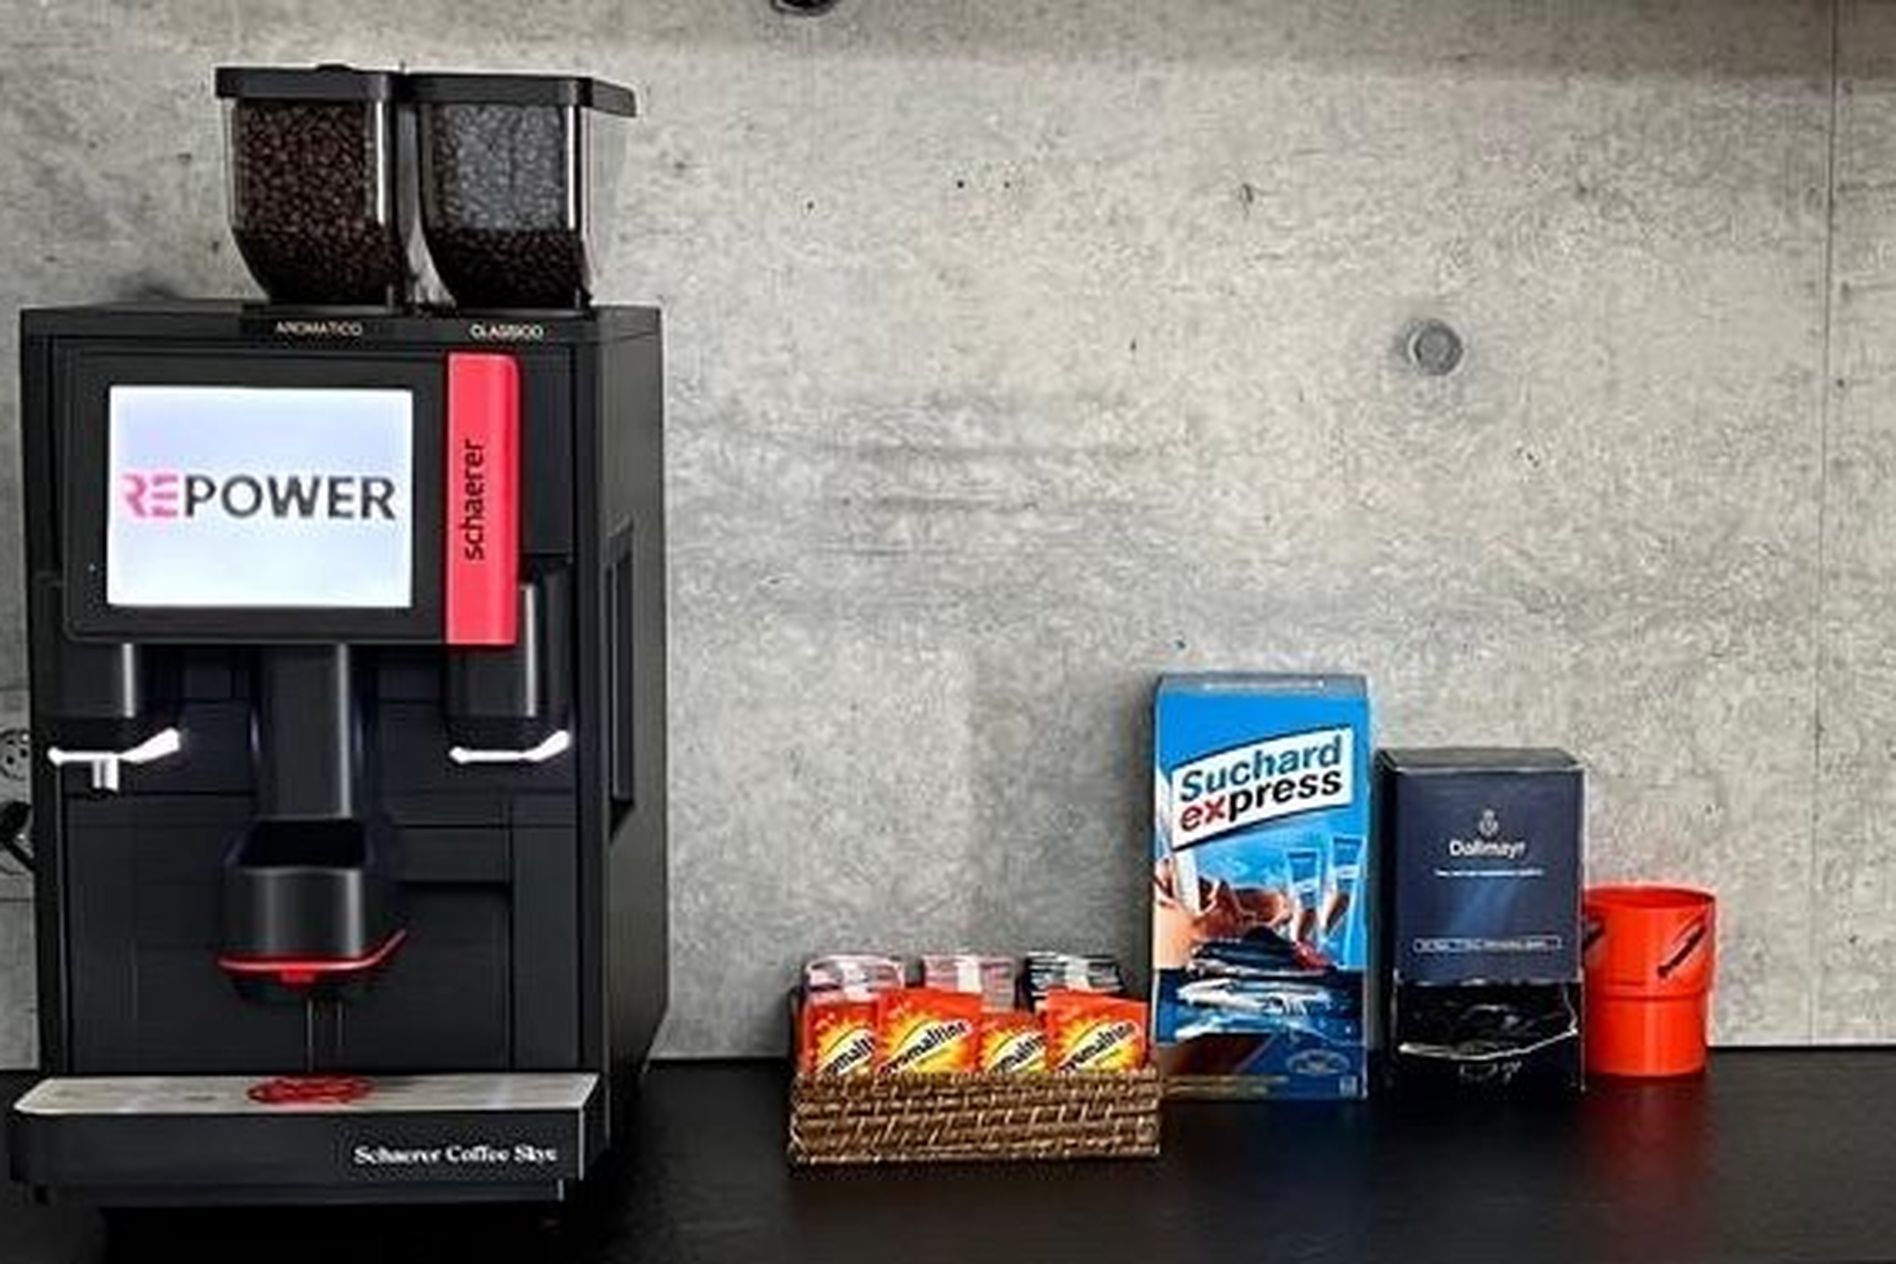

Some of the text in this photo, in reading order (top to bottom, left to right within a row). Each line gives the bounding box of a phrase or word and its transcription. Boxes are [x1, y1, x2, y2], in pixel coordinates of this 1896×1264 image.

[122, 473, 396, 520] REPOWER
[458, 438, 485, 561] schaerer
[1180, 734, 1343, 803] Suchard
[1180, 770, 1343, 832] express
[1449, 839, 1526, 860] Dallmayr
[354, 1145, 441, 1165] Schaerer
[446, 1144, 510, 1163] Coffee
